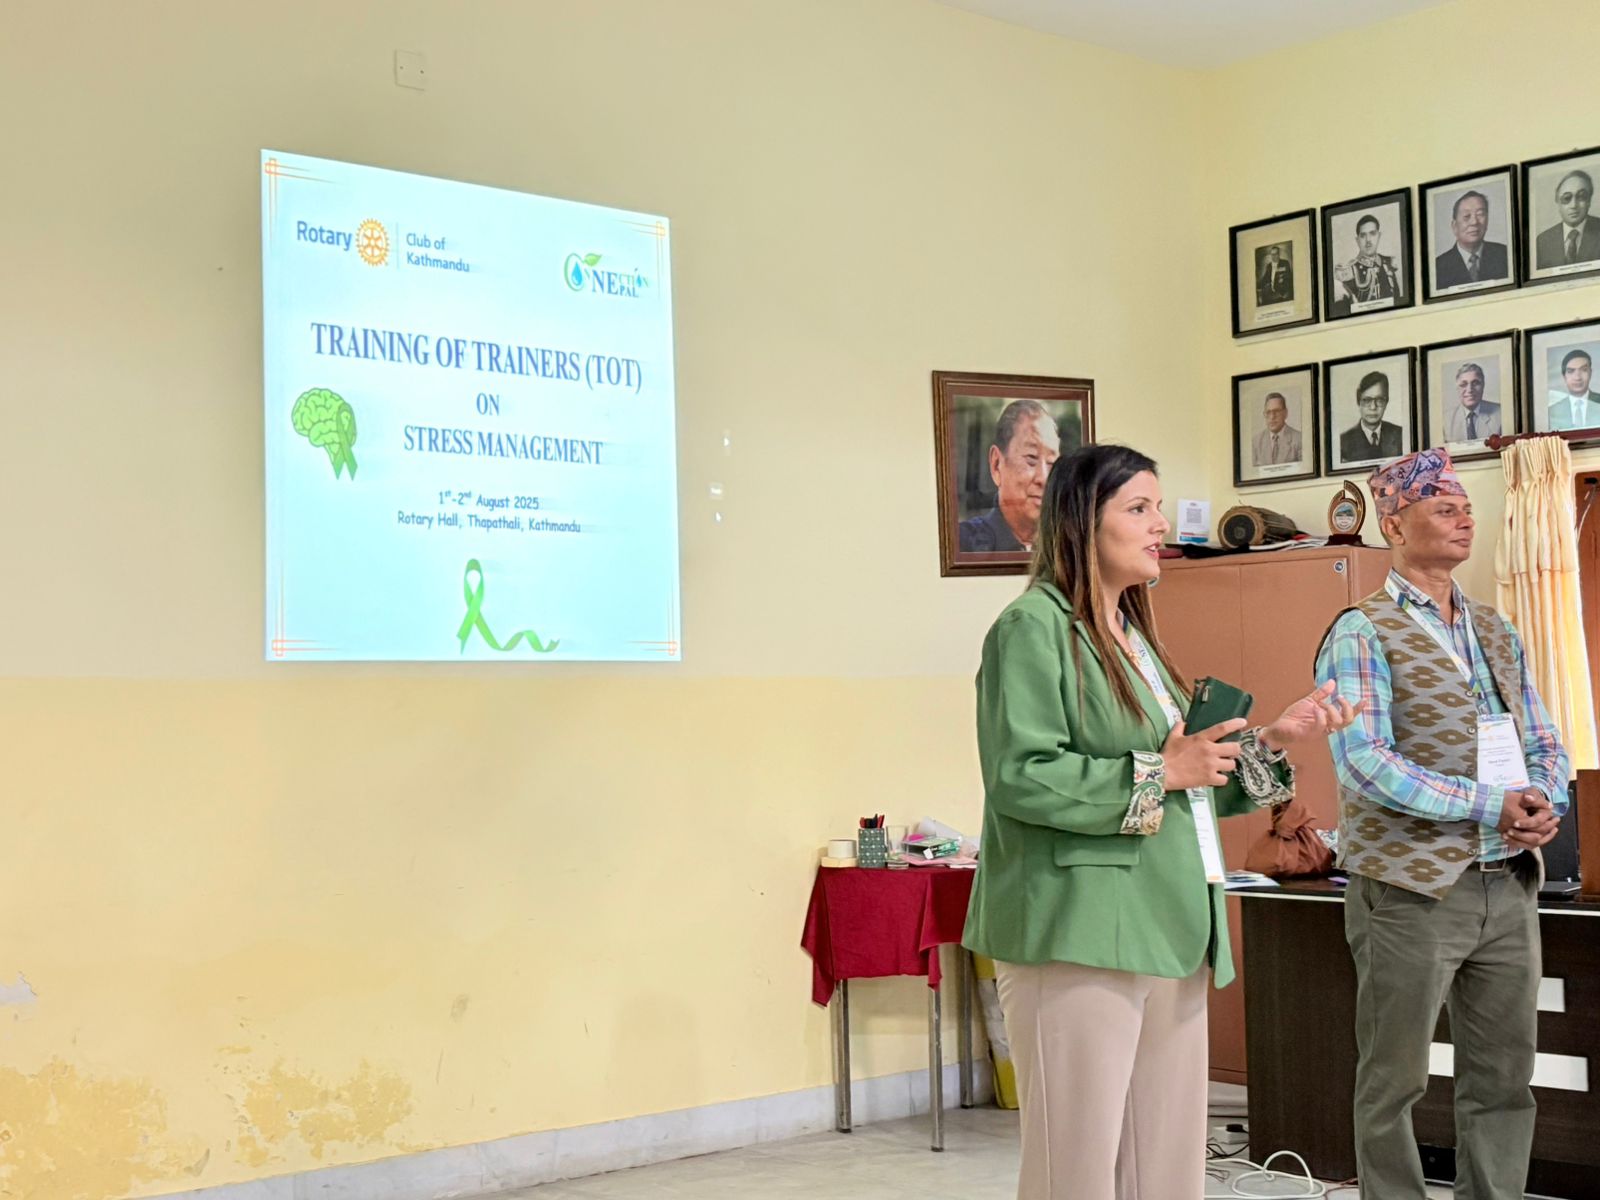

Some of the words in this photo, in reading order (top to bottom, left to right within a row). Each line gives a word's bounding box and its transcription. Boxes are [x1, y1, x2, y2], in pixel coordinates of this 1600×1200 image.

[297, 220, 353, 251] Rotary
[406, 233, 431, 249] Club
[434, 237, 446, 250] of
[406, 252, 470, 273] Kathmandu
[311, 322, 429, 366] TRAINING
[436, 337, 467, 369] OF
[472, 341, 580, 381] TRAINERS
[586, 354, 642, 394] (TOT)
[476, 392, 500, 416] ON
[404, 424, 473, 455] STRESS
[477, 431, 604, 465] MANAGEMENT
[476, 494, 510, 511] August
[514, 496, 539, 510] 2025
[397, 510, 433, 529] Rotary
[438, 512, 462, 529] Hall,
[467, 514, 525, 533] Thapathali,
[529, 517, 581, 533] Kathmandu
